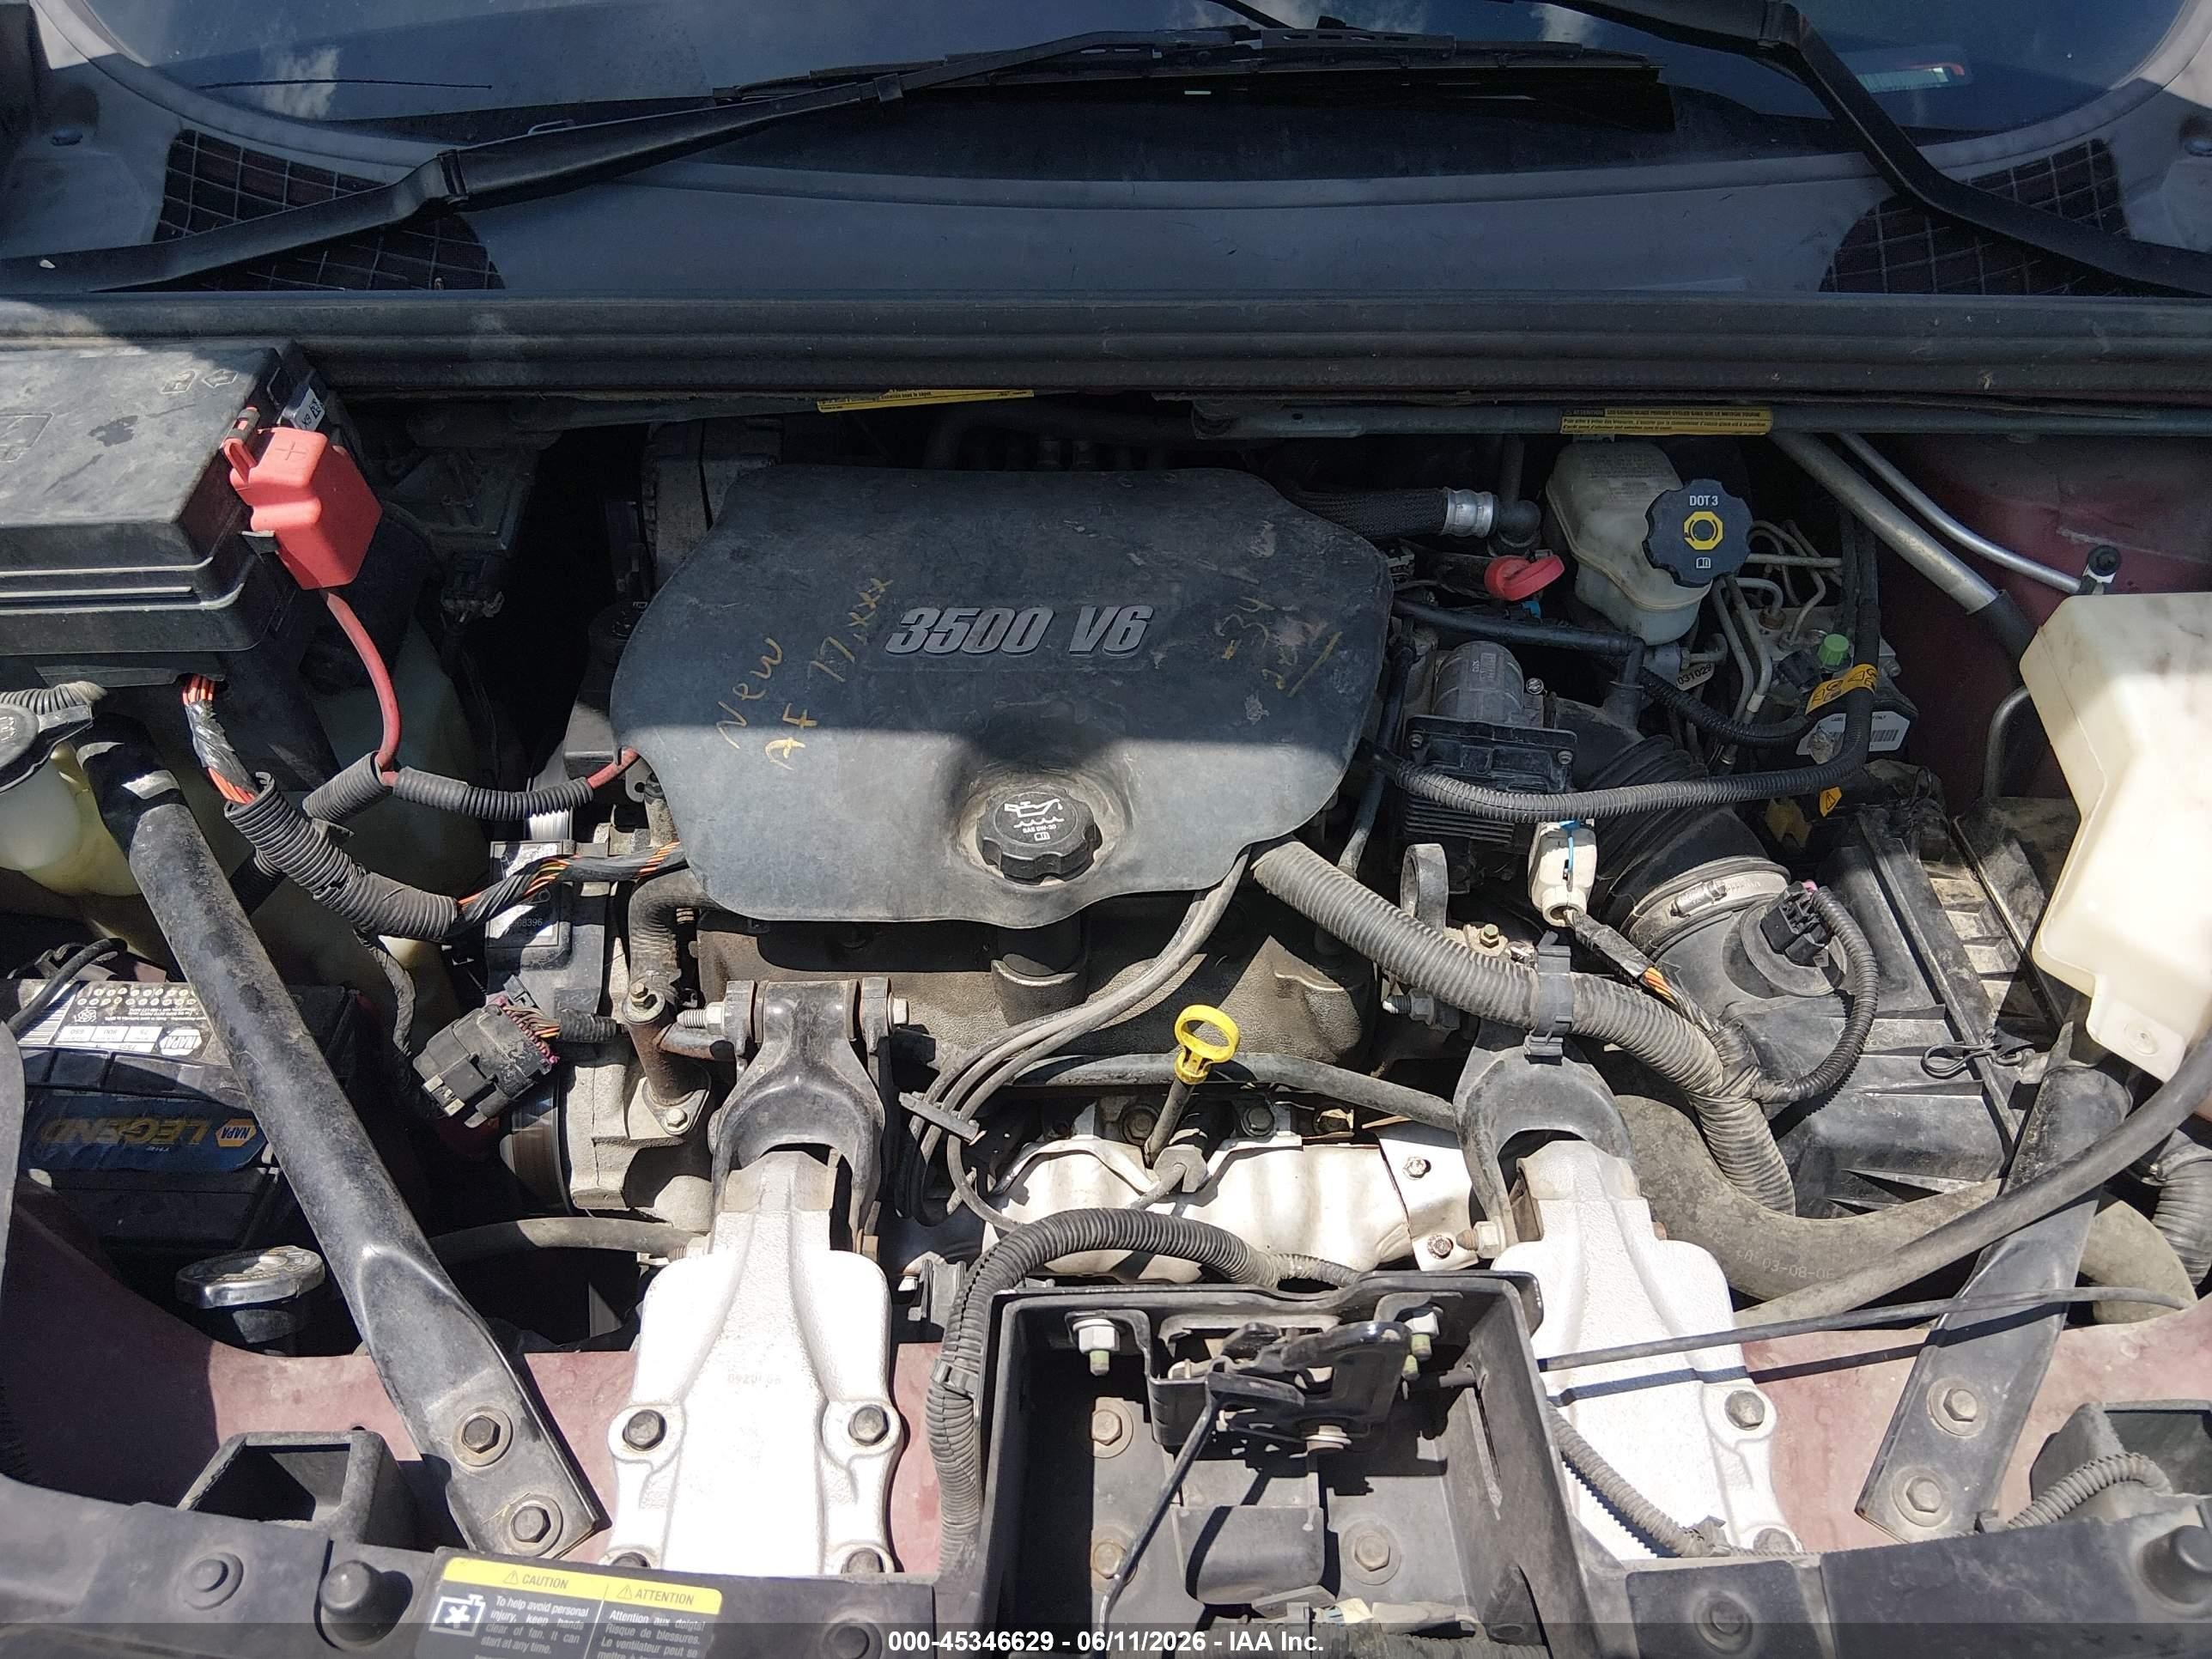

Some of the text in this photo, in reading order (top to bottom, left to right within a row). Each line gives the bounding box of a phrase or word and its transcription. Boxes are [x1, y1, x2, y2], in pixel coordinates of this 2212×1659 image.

[1689, 495, 1718, 507] DOT 3
[885, 605, 1154, 656] 3500 V6
[166, 1036, 197, 1049] NAPA
[43, 1118, 212, 1146] LEGEND
[220, 1126, 251, 1139] NAPA
[521, 1573, 569, 1589] CAUTION
[495, 1595, 589, 1618] To help avoid personal
[635, 1589, 695, 1605] ATTENTION
[526, 1613, 549, 1628] keep
[557, 1617, 585, 1631] hands
[609, 1609, 706, 1632] Attention aux doigts!
[485, 1623, 580, 1644] clear of fan. It can
[605, 1623, 701, 1645] Risque de blessures.
[480, 1635, 552, 1655] start at any time.
[601, 1636, 613, 1647] Le
[616, 1638, 661, 1654] ventilateur
[663, 1645, 684, 1657] peut
[687, 1648, 698, 1657] se
